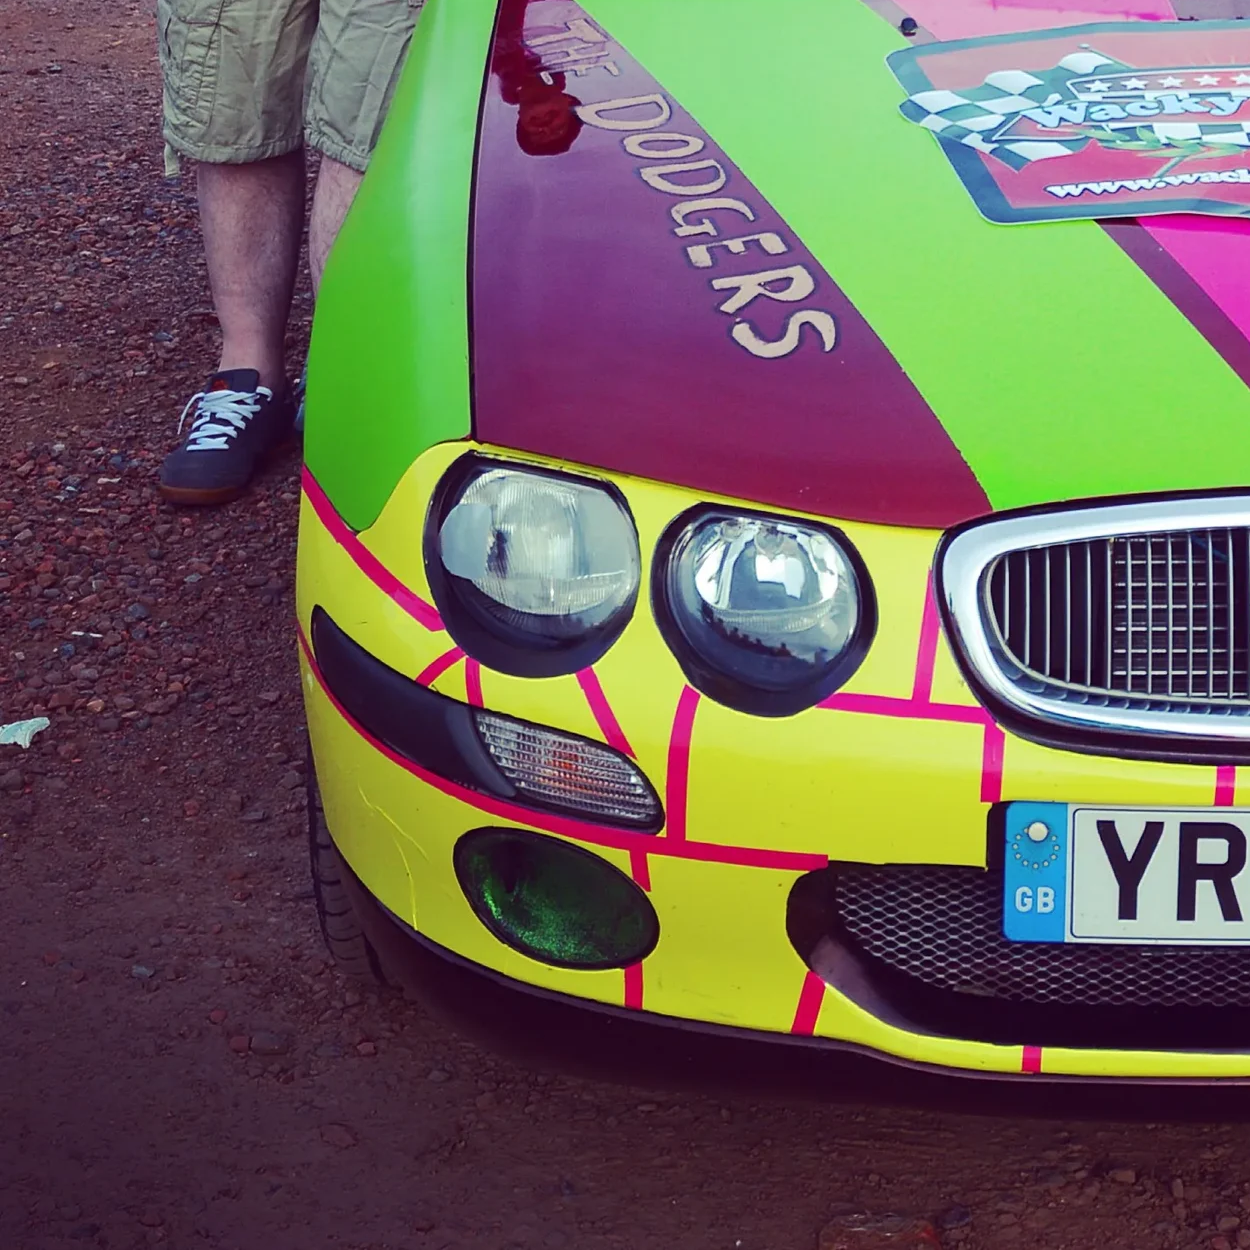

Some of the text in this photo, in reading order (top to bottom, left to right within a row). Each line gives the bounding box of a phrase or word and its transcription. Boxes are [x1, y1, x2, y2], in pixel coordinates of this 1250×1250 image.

[1021, 89, 1250, 129] Wacky
[524, 16, 837, 360] THE DODGERS
[1015, 886, 1055, 913] GB
